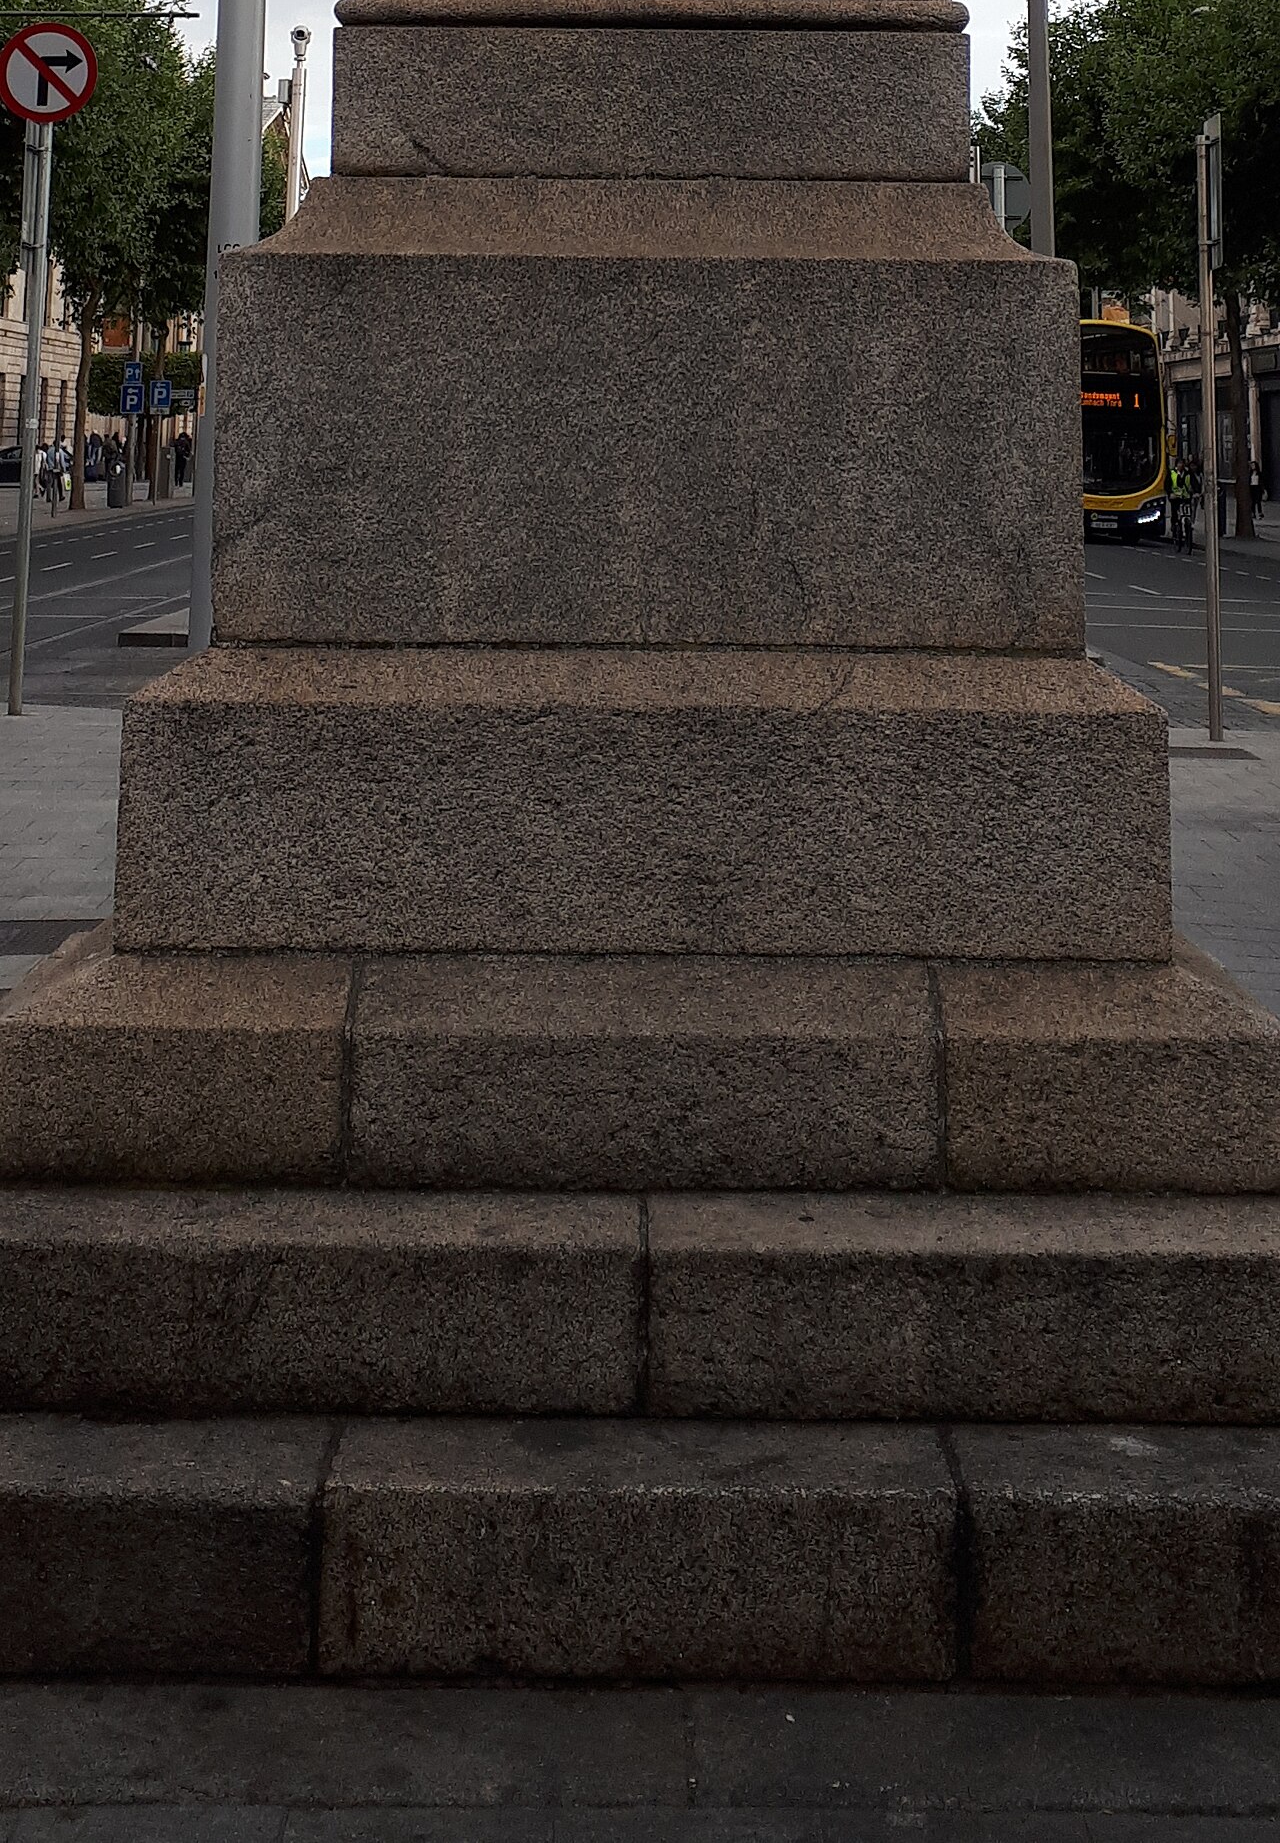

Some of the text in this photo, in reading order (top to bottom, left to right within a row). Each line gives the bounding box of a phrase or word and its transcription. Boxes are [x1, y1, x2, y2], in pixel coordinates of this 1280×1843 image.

[126, 395, 138, 410] P
[154, 388, 167, 405] P
[1133, 393, 1140, 408] 1
